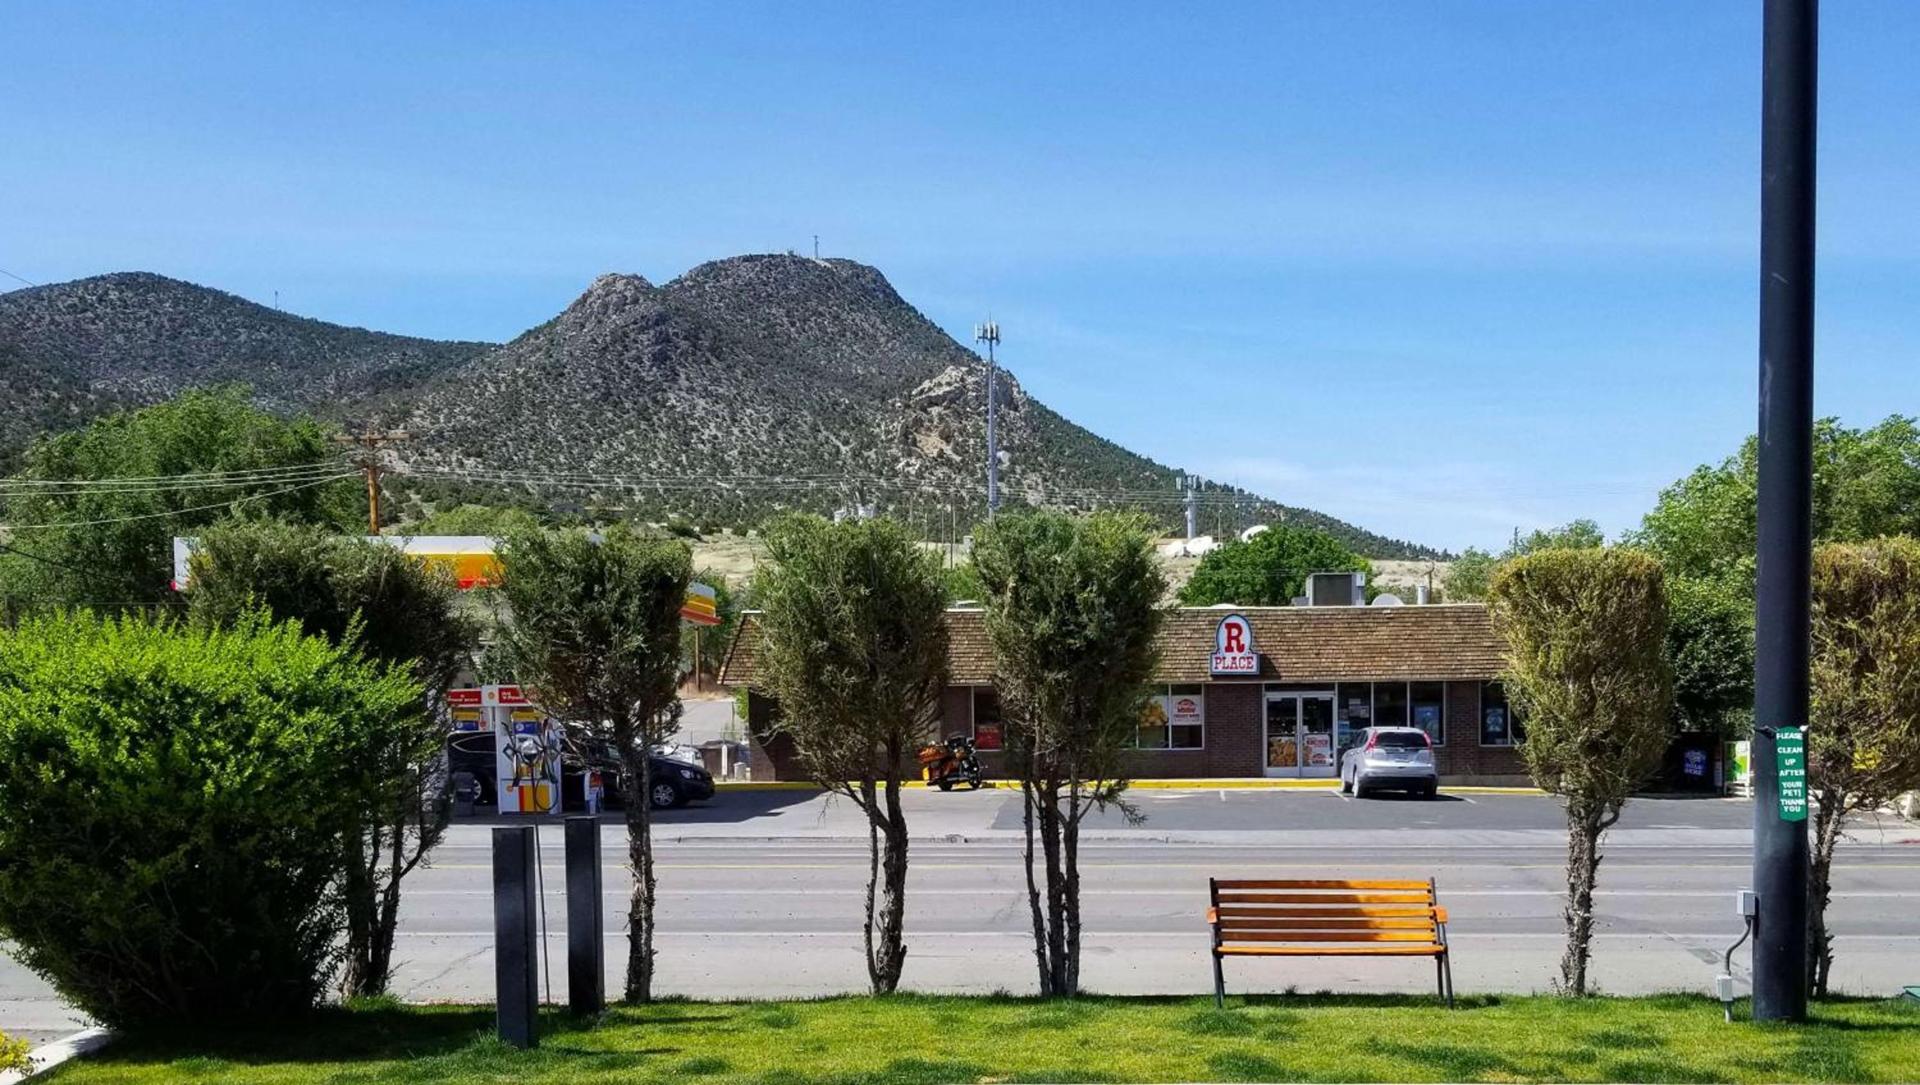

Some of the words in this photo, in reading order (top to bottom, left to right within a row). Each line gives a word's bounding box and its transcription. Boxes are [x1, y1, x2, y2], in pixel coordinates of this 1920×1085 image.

[1224, 622, 1245, 653] R
[1214, 656, 1254, 670] PLACE
[1776, 732, 1803, 740] PLEASE
[1777, 746, 1803, 754] CLEAN
[1784, 758, 1796, 766] UP
